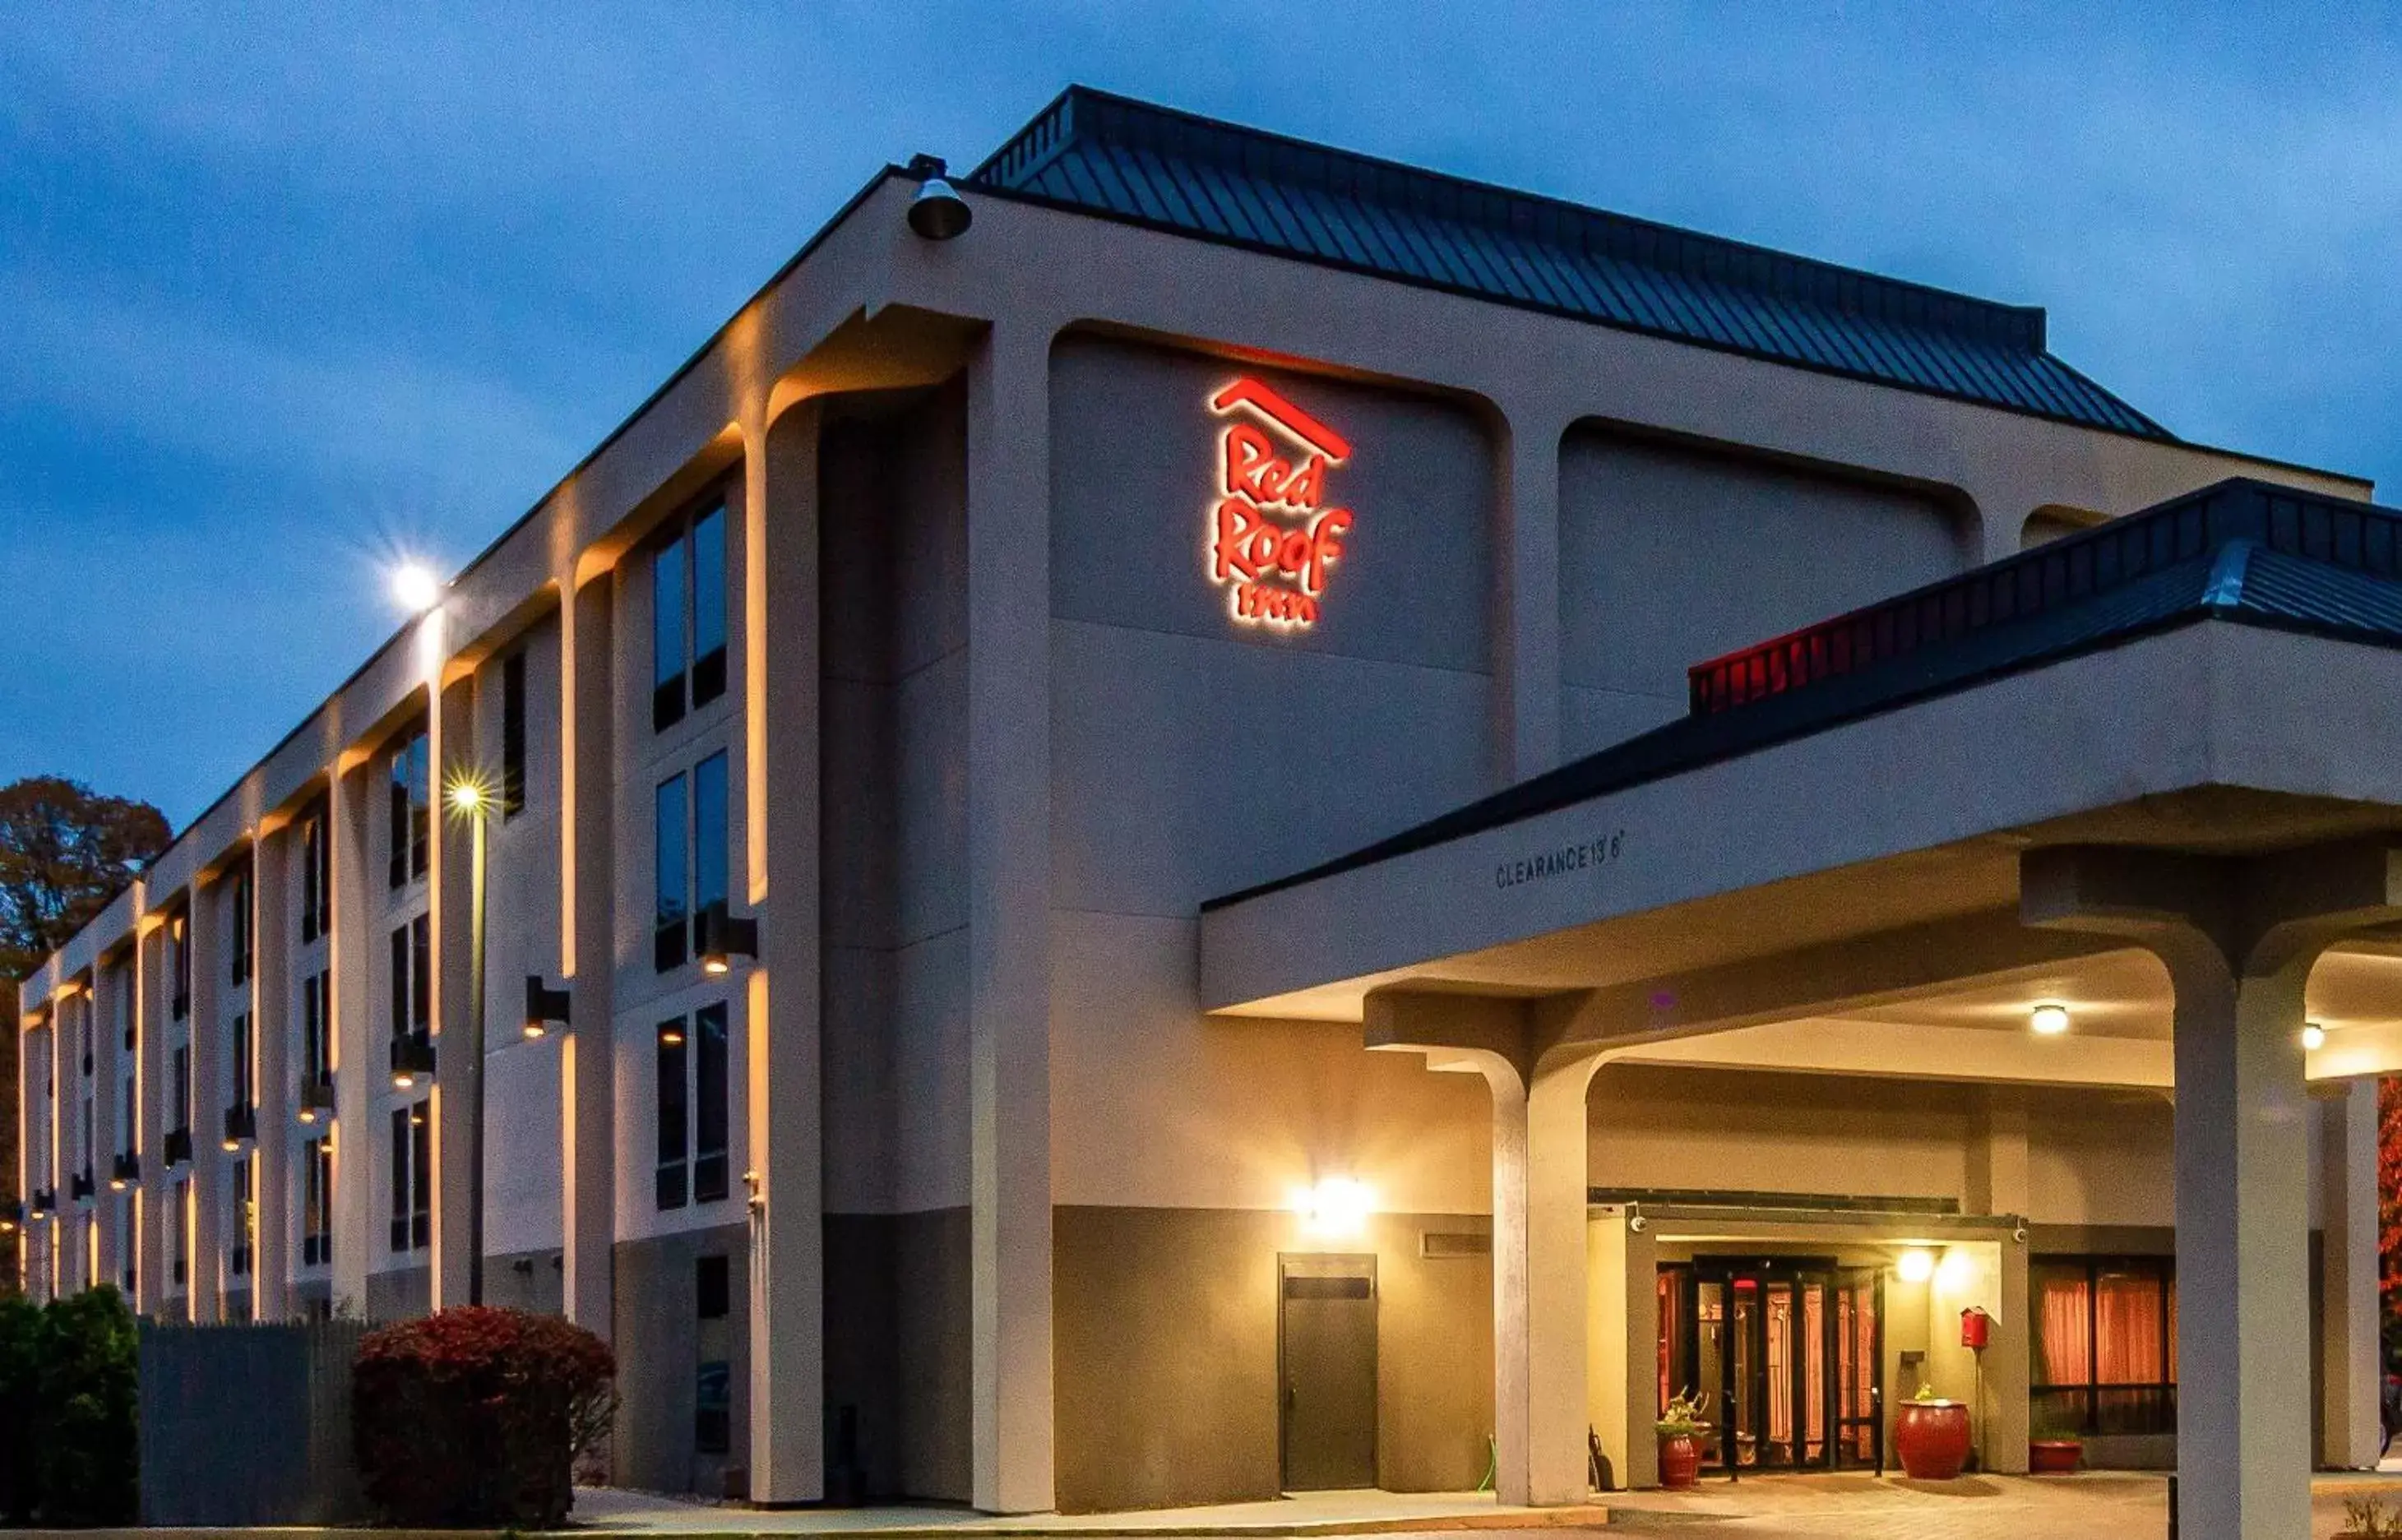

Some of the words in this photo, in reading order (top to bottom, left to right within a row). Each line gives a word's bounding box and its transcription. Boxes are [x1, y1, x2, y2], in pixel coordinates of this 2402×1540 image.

[1225, 423, 1325, 507] Red
[1214, 498, 1354, 592] Roof
[1496, 845, 1588, 889] CLEARANCE
